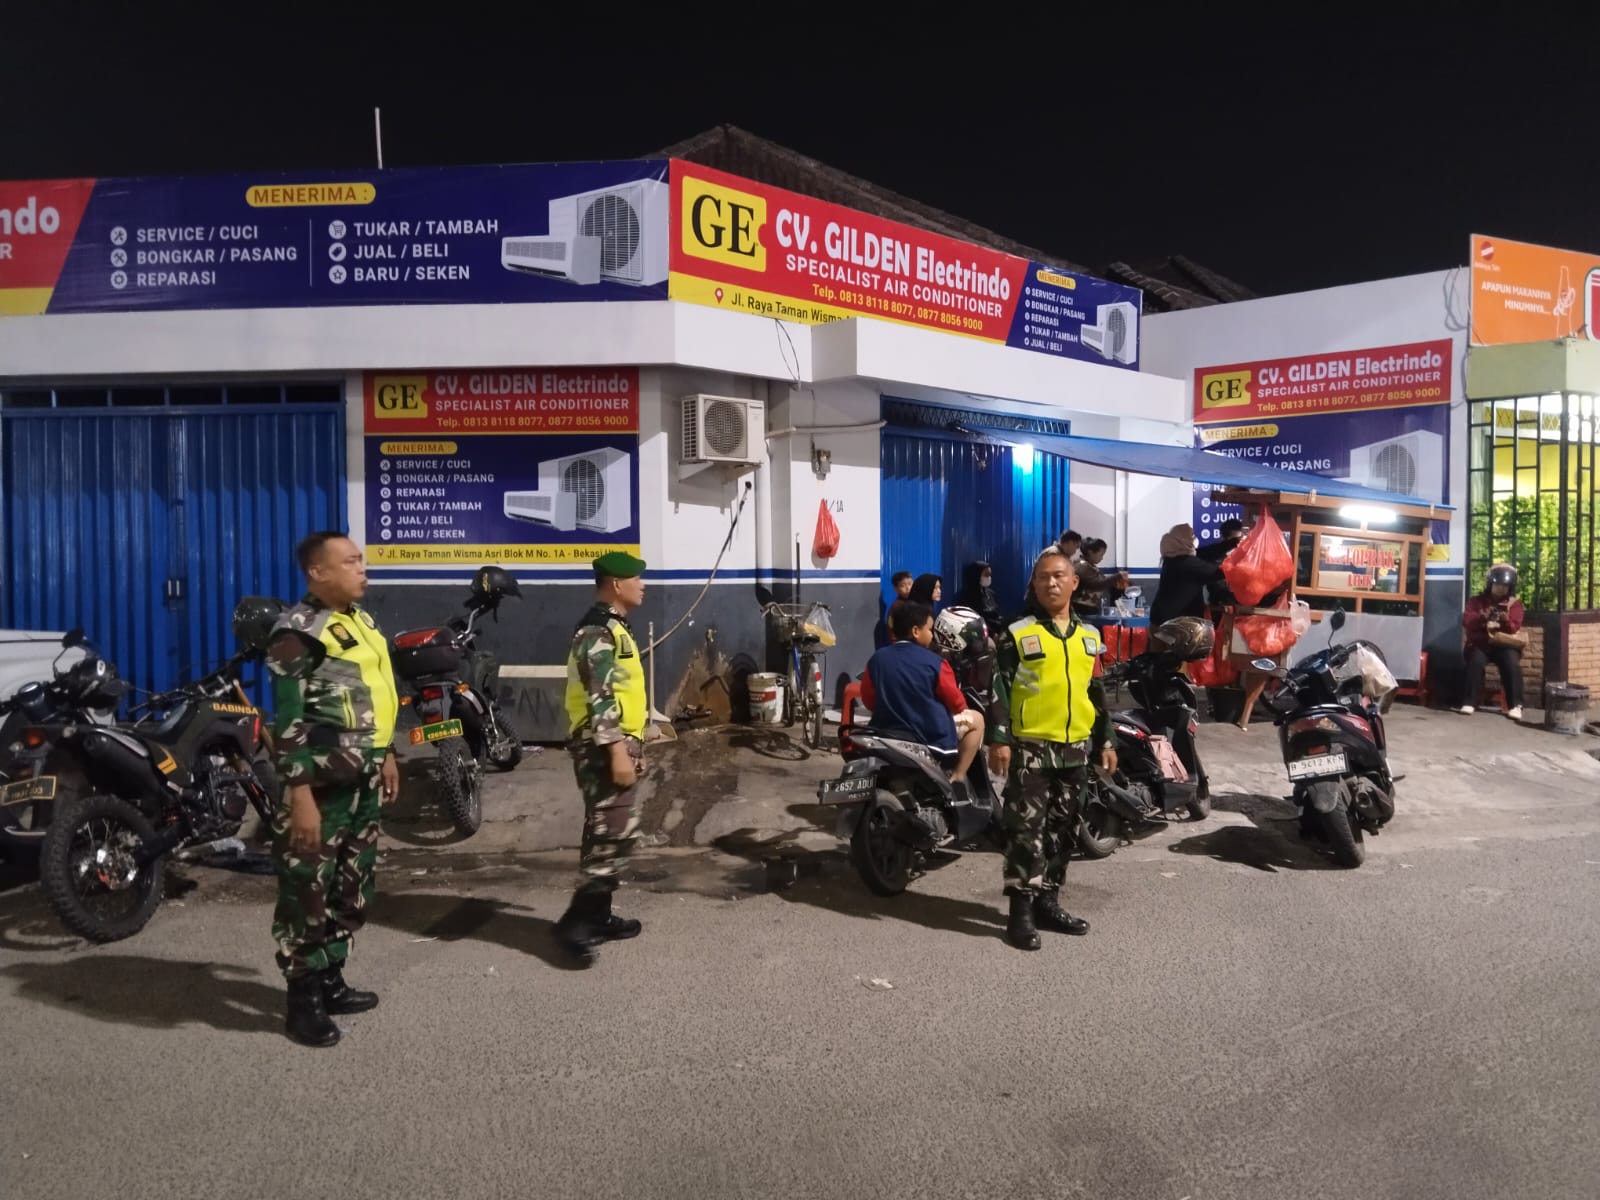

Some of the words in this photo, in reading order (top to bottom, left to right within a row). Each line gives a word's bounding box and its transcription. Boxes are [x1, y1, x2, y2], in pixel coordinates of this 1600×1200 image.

[254, 186, 357, 204] MENERIMA
[353, 221, 411, 237] TUKAR
[426, 219, 498, 235] TAMBAH
[691, 193, 756, 258] GE
[136, 227, 205, 243] SERVICE
[219, 225, 258, 241] CUCI
[136, 249, 215, 265] BONGKAR
[230, 246, 298, 262] PASANG
[353, 244, 397, 259] JUAL
[412, 243, 448, 258] BELI
[775, 208, 818, 254] CV.
[824, 222, 910, 277] GILDEN
[916, 247, 1010, 300] Electrindo
[136, 271, 216, 287] REPARASI
[353, 266, 400, 281] BARU
[415, 265, 470, 281] SEKEN
[786, 253, 881, 291] SPECIALIST
[884, 280, 908, 297] AIR
[912, 285, 1003, 318] CONDITIONER
[1031, 288, 1056, 302] SERVICE
[1060, 295, 1074, 305] CUCI
[747, 297, 773, 317] Raya
[775, 302, 808, 320] Taman
[812, 283, 837, 301] Telp.
[840, 289, 864, 306] 0813
[865, 294, 890, 310] 8118
[891, 299, 916, 318] 8077,
[917, 306, 939, 322] 0877
[940, 311, 961, 326] 8056
[962, 316, 983, 331] 9000
[1031, 301, 1059, 314] BONGKAR
[1063, 308, 1086, 320] PASANG
[1031, 313, 1059, 326] REPARASI
[1031, 326, 1050, 338] TUKAR
[1055, 331, 1079, 343] TAMBAH
[1030, 339, 1046, 349] JUAL
[1049, 342, 1063, 352] BELI
[1258, 367, 1284, 386] CV.
[1288, 359, 1351, 383] GILDEN
[1355, 350, 1442, 375] Electrindo
[434, 376, 465, 396] CV.
[469, 375, 537, 395] GILDEN
[541, 373, 629, 394] Electrindo
[1205, 377, 1243, 402] GE
[1257, 383, 1326, 398] SPECIALIST
[1329, 381, 1349, 392] AIR
[1353, 372, 1441, 389] CONDITIONER
[377, 383, 418, 410] GE
[1257, 402, 1279, 413] Telp.
[1281, 400, 1304, 410] 0813
[1306, 398, 1330, 408] 8118
[1360, 393, 1384, 403] 0877
[1387, 390, 1413, 401] 8056
[1415, 387, 1441, 398] 9000
[435, 399, 511, 412] SPECIALIST
[514, 399, 536, 411] AIR
[540, 398, 629, 411] CONDITIONER
[437, 417, 461, 428] Telp.
[463, 417, 489, 427] 0813
[491, 417, 516, 426] 8118
[518, 416, 546, 428] 8077,
[548, 416, 573, 426] 0877
[575, 415, 601, 426] 8056
[603, 415, 629, 425] 9000
[1205, 426, 1268, 440] MENERIMA
[386, 443, 445, 453] MENERIMA
[1273, 443, 1302, 456] CUCI
[396, 460, 438, 470] SERVICE
[447, 459, 471, 469] CUCI
[1280, 459, 1331, 471] PASANG
[396, 474, 445, 484] BONGKAR
[453, 474, 495, 483] PASANG
[396, 487, 445, 497] REPARASI
[396, 502, 430, 511] TUKAR
[437, 501, 482, 511] TAMBAH
[396, 515, 422, 525] JUAL
[431, 515, 453, 525] BELI
[396, 529, 424, 539] BARU
[432, 529, 466, 539] SEKEN
[400, 549, 421, 561] Raya
[423, 549, 451, 559] Taman
[453, 549, 483, 559] Wisma
[484, 549, 502, 558] Asri
[504, 549, 524, 558] Blok
[525, 549, 534, 558] M
[536, 549, 552, 558] No.
[212, 702, 259, 716] BABINSA
